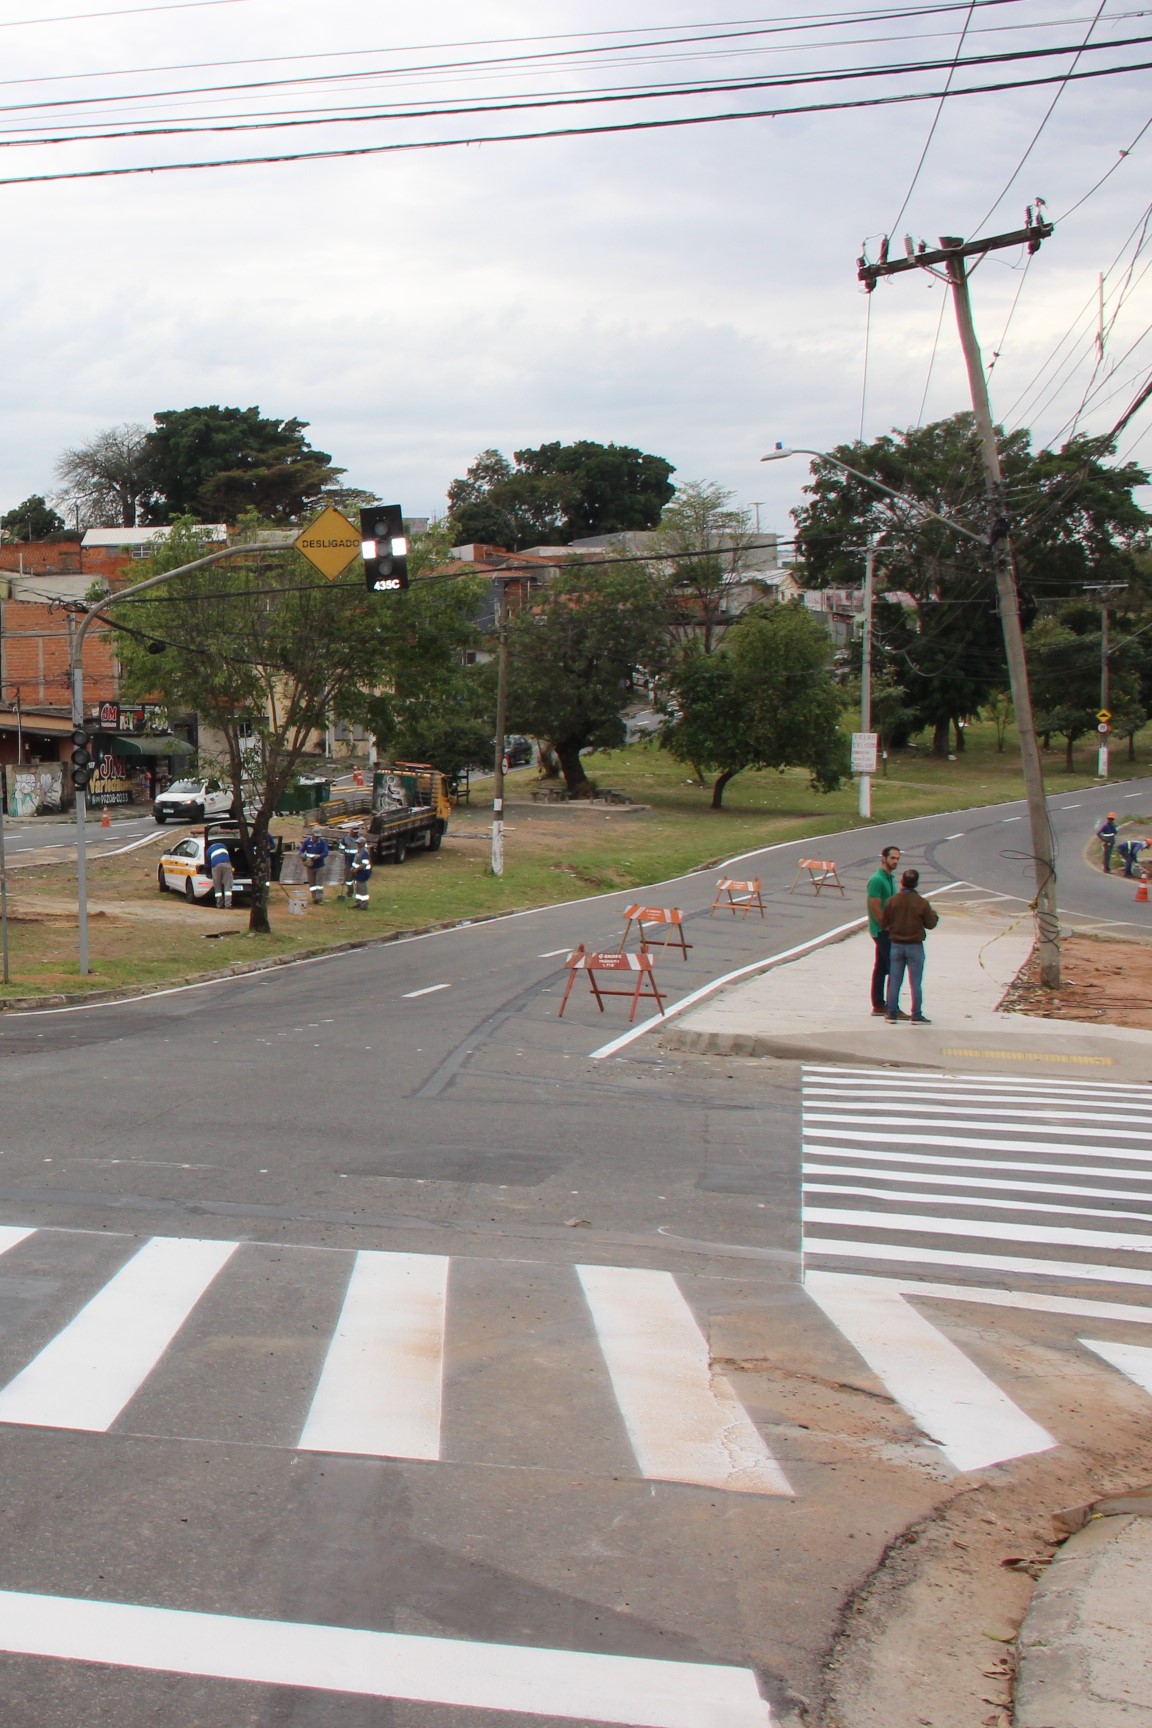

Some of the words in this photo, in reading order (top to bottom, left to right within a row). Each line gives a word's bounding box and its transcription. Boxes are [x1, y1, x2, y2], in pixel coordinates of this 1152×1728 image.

[302, 539, 360, 549] DESLIGADO
[373, 579, 401, 591] 435C
[101, 705, 117, 721] JM
[100, 755, 127, 778] JM
